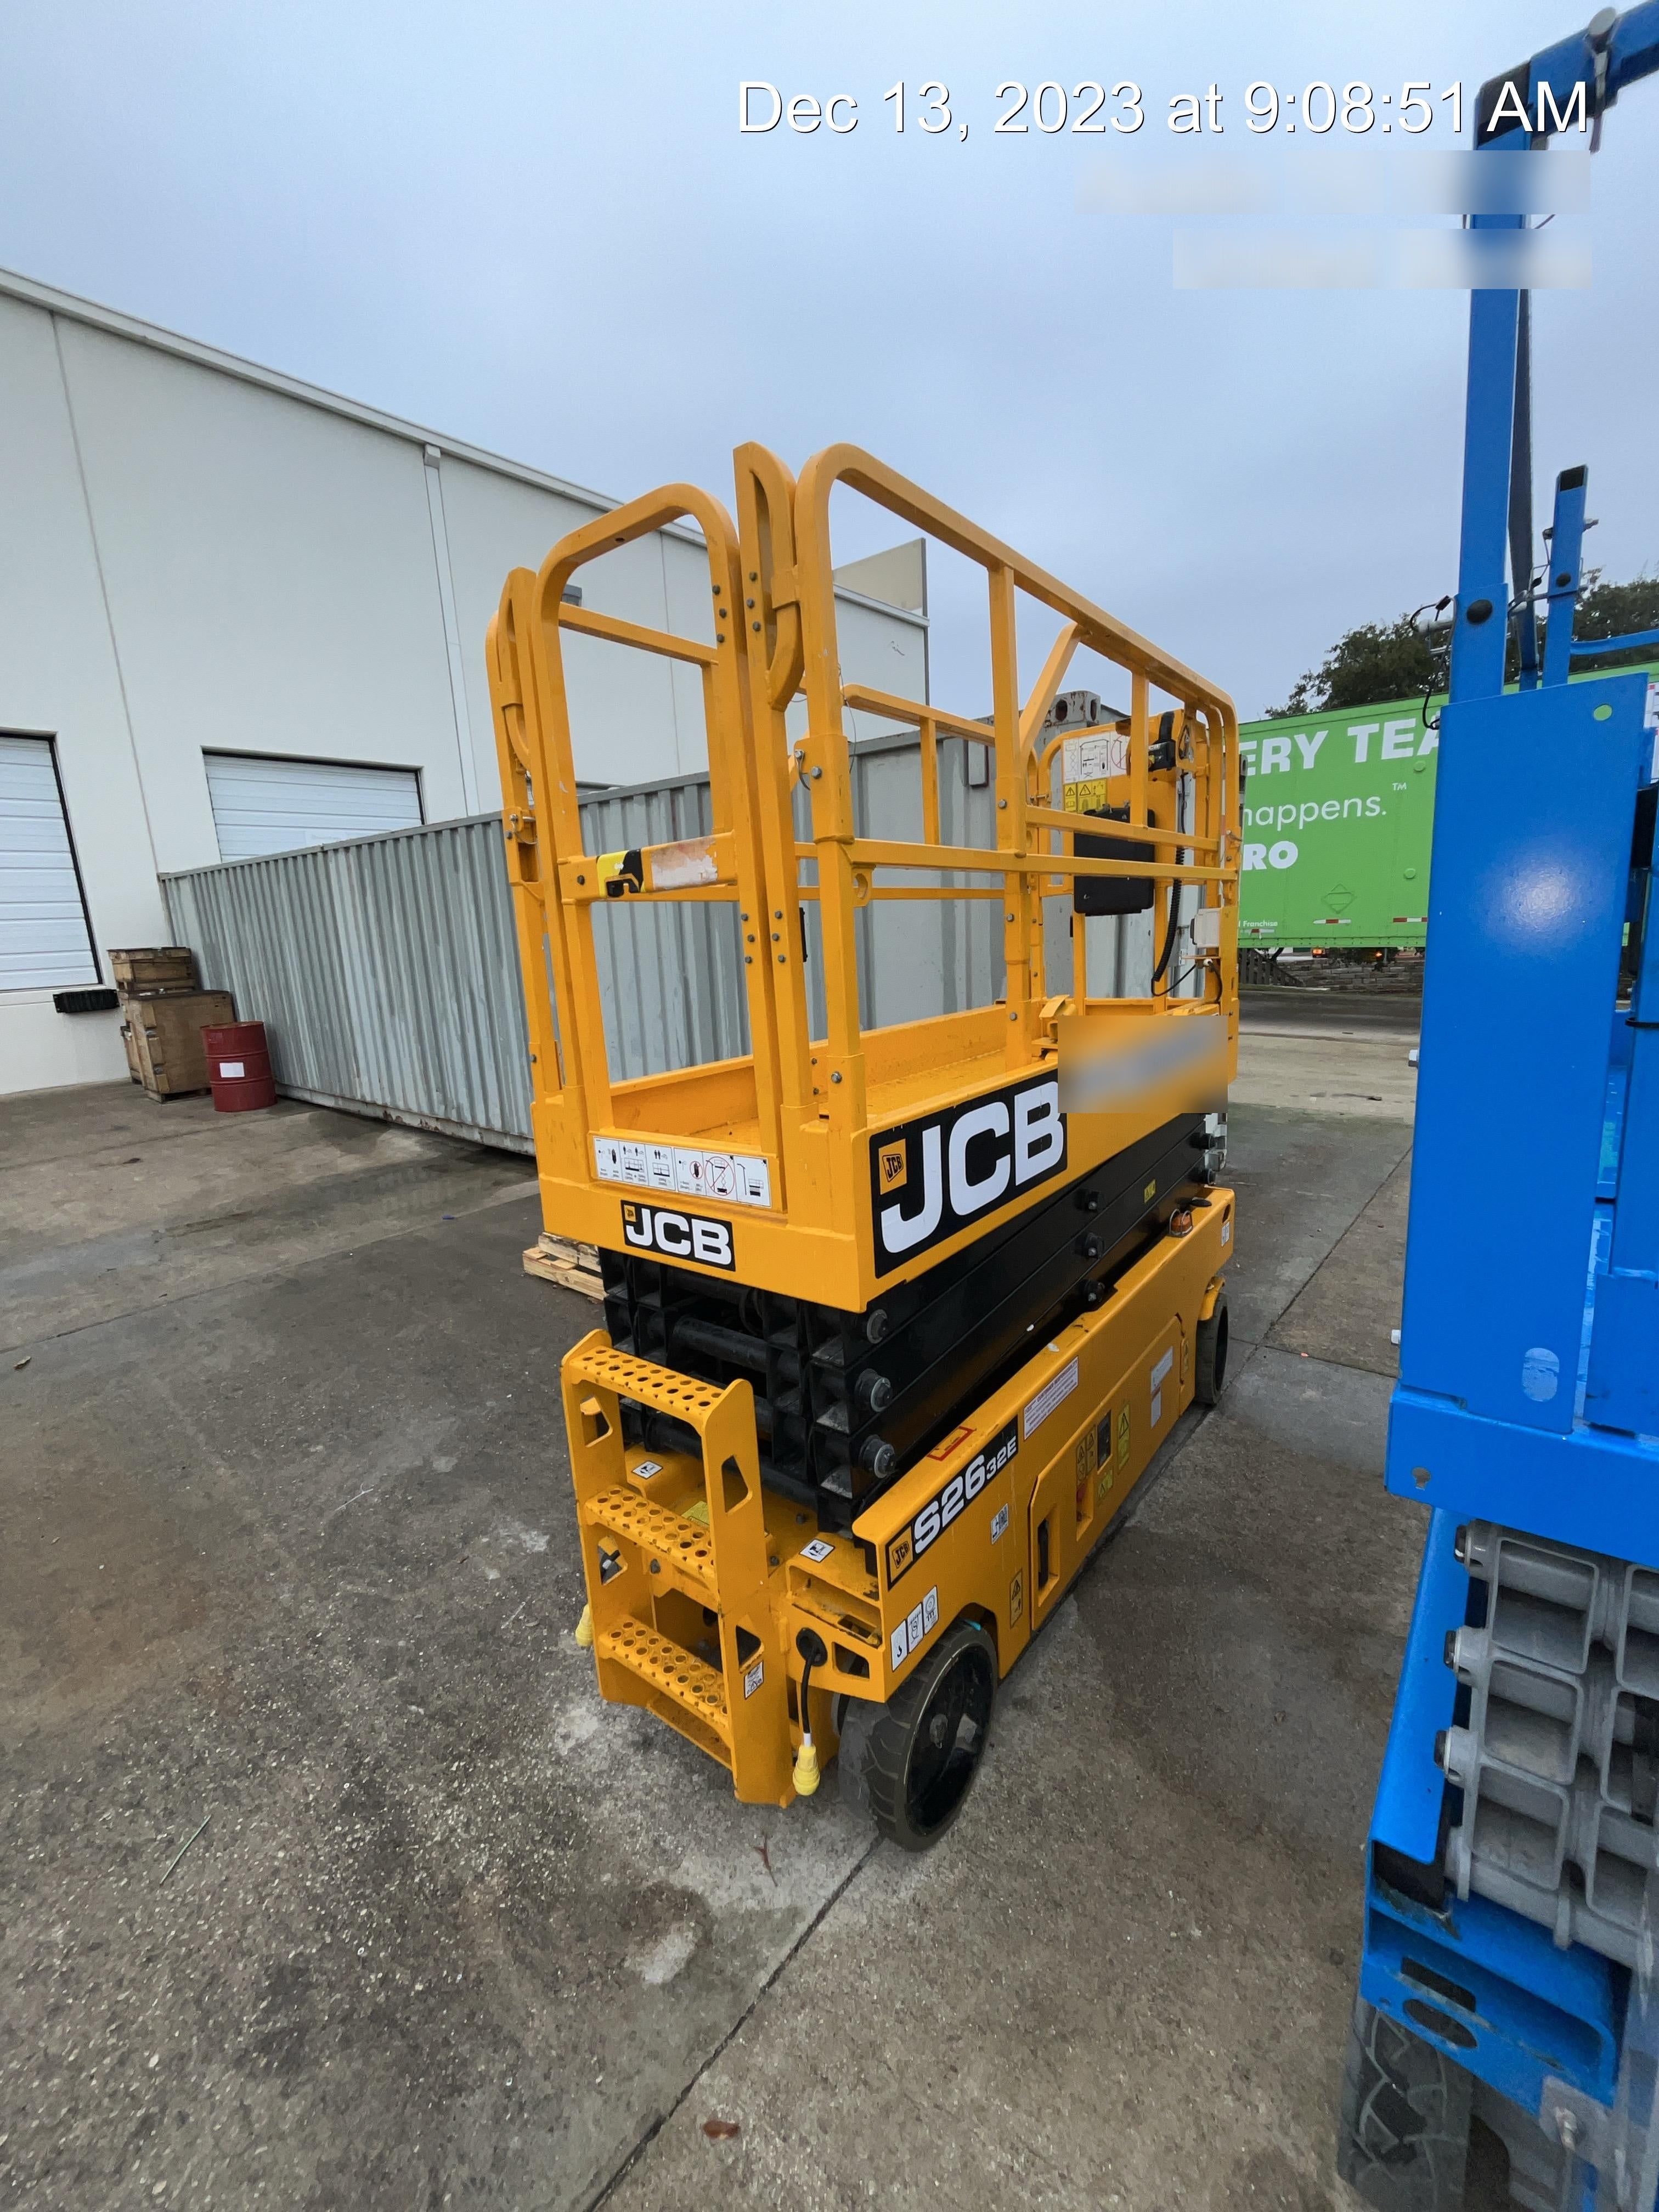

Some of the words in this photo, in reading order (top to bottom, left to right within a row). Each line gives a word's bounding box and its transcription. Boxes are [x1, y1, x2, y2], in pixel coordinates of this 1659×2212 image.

[1242, 840, 1299, 871] RO
[881, 1081, 1064, 1254] JCB
[886, 1156, 902, 1179] JCB
[626, 1207, 732, 1265] JCB
[895, 1541, 910, 1565] JCB
